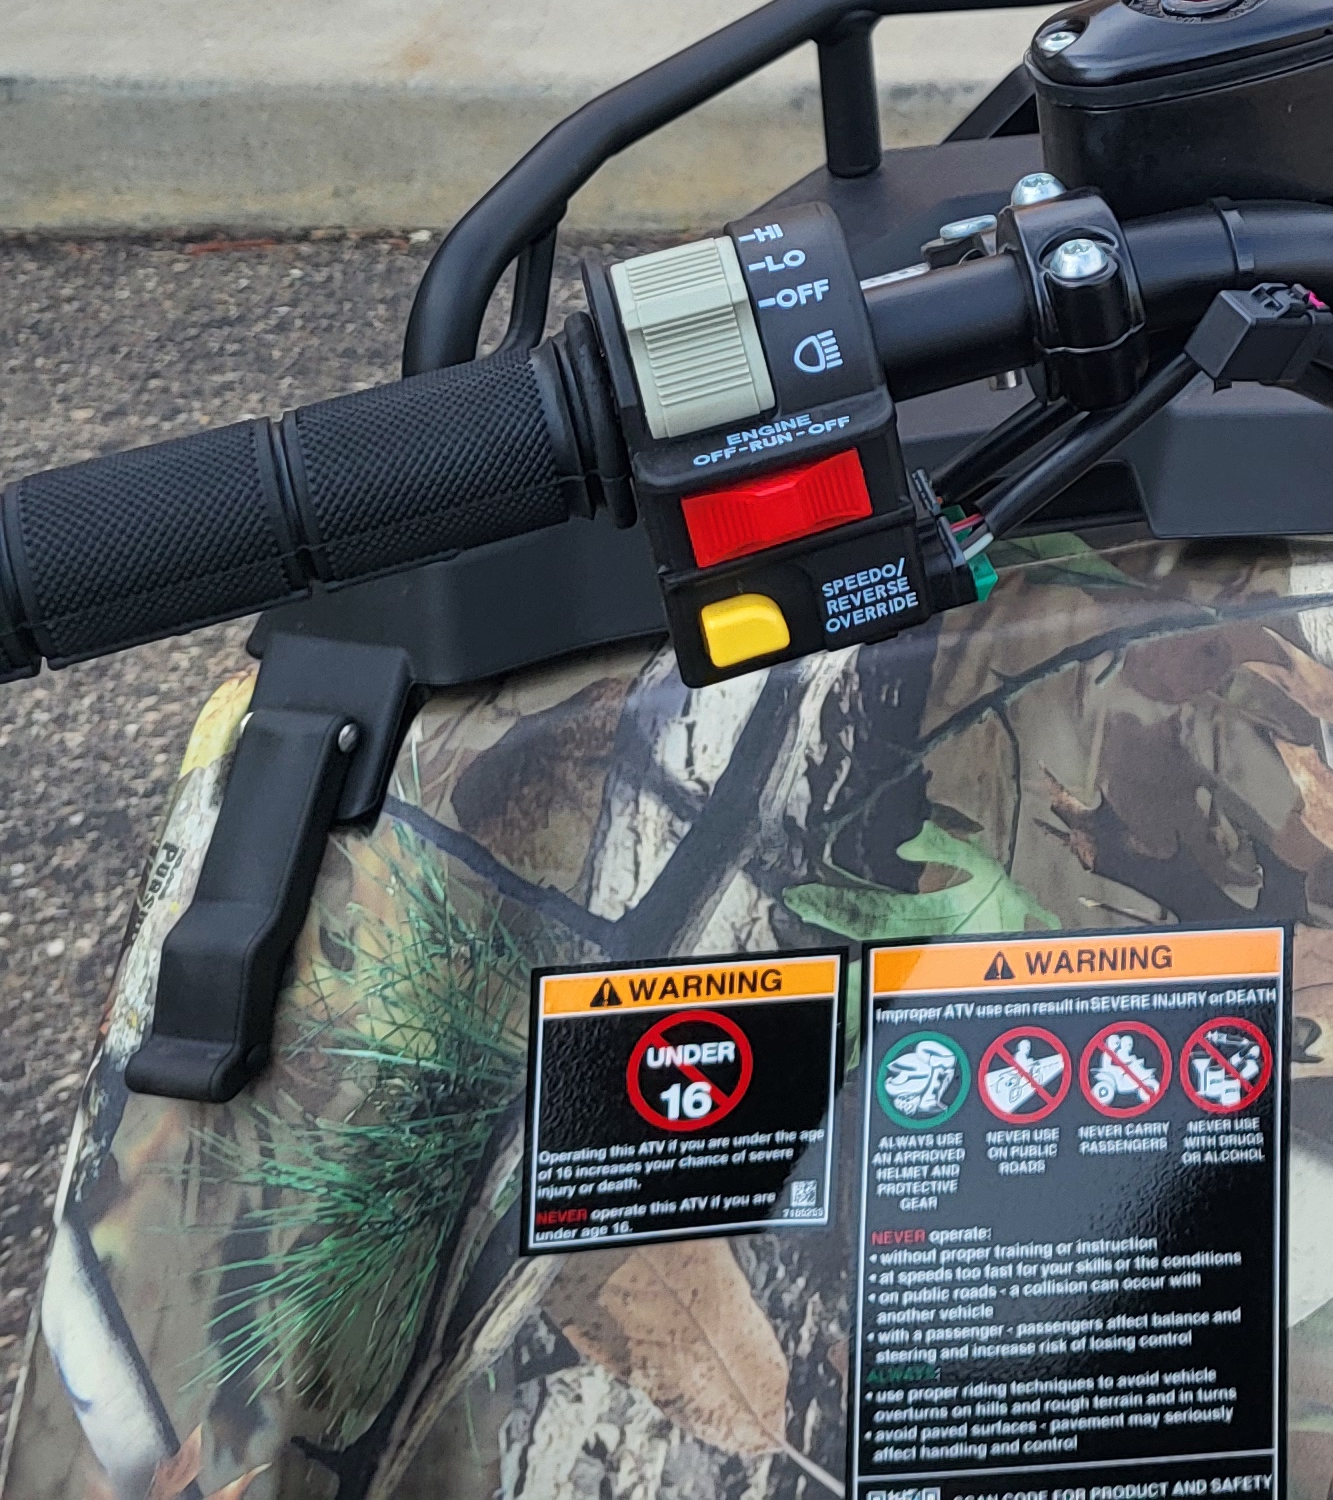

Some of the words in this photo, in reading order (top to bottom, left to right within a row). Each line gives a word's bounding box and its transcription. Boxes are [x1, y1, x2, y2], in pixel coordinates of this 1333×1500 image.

[727, 414, 812, 446] ENGINE
[821, 558, 905, 598] SPEEDO/
[826, 577, 911, 614] REVERSE
[825, 591, 918, 634] OVERRIDE
[1025, 945, 1172, 975] WARNING
[629, 968, 782, 1002] WARNING
[877, 1005, 942, 1025] Improper
[943, 1003, 974, 1017] ATV
[976, 1005, 1001, 1016] use
[1006, 1003, 1031, 1014] can
[1032, 998, 1073, 1013] result
[1076, 997, 1089, 1011] in
[1091, 994, 1150, 1010] SEVERE
[1152, 991, 1207, 1007] INJURY
[1210, 994, 1225, 1004] or
[1226, 988, 1276, 1003] DEATH
[646, 1041, 735, 1068] UNDER
[660, 1081, 712, 1121] 16
[1078, 1125, 1122, 1140] NEVER
[1125, 1122, 1169, 1137] CARRY
[1080, 1138, 1167, 1154] PASSENGERS
[539, 1146, 606, 1167] Operating
[611, 1144, 635, 1157] this
[639, 1141, 666, 1155] ATV
[669, 1140, 678, 1153] if
[680, 1141, 705, 1156] you
[708, 1139, 729, 1150] are
[733, 1133, 772, 1148] under
[775, 1131, 796, 1144] the
[800, 1131, 824, 1146] age
[538, 1167, 552, 1180] of
[557, 1165, 572, 1178] 16
[576, 1160, 641, 1177] increases
[645, 1160, 675, 1176] your
[678, 1153, 728, 1169] chance
[732, 1152, 746, 1165] of
[749, 1151, 794, 1163] severe
[537, 1182, 575, 1201] injury
[580, 1184, 594, 1194] or
[536, 1208, 587, 1224] NEVER
[591, 1202, 646, 1224] operate
[650, 1200, 676, 1214] this
[680, 1197, 708, 1211] ATV
[711, 1196, 720, 1208] if
[723, 1196, 747, 1211] you
[751, 1193, 776, 1205] are
[536, 1225, 576, 1240] under
[580, 1226, 607, 1241] age
[872, 1230, 925, 1245] NEVER
[880, 1248, 937, 1263] without
[941, 1248, 991, 1264] proper
[995, 1242, 1053, 1261] training
[1056, 1244, 1073, 1253] or
[1076, 1236, 1157, 1252] instruction
[880, 1271, 894, 1284] at
[898, 1268, 952, 1287] speeds
[956, 1266, 981, 1280] too
[984, 1265, 1013, 1278] fast
[1017, 1263, 1037, 1276] for
[1041, 1264, 1073, 1280] your
[1076, 1259, 1112, 1273] skills
[1116, 1261, 1132, 1271] or
[1134, 1257, 1159, 1270] the
[1162, 1252, 1241, 1268] conditions
[876, 1308, 936, 1323] another
[939, 1305, 993, 1320] vehicle
[876, 1391, 904, 1402] use
[908, 1388, 958, 1404] proper
[962, 1382, 1008, 1401] riding
[1011, 1378, 1094, 1399] techniques
[1098, 1376, 1113, 1389] to
[1117, 1374, 1160, 1388] avoid
[1163, 1371, 1217, 1386] vehicle
[873, 1448, 916, 1462] affect
[920, 1444, 987, 1464] handling
[990, 1442, 1020, 1455] and
[1022, 1439, 1077, 1454] control
[1090, 1481, 1169, 1499] PRODUCT
[1172, 1479, 1207, 1495] AND
[1210, 1475, 1272, 1493] SAFETY
